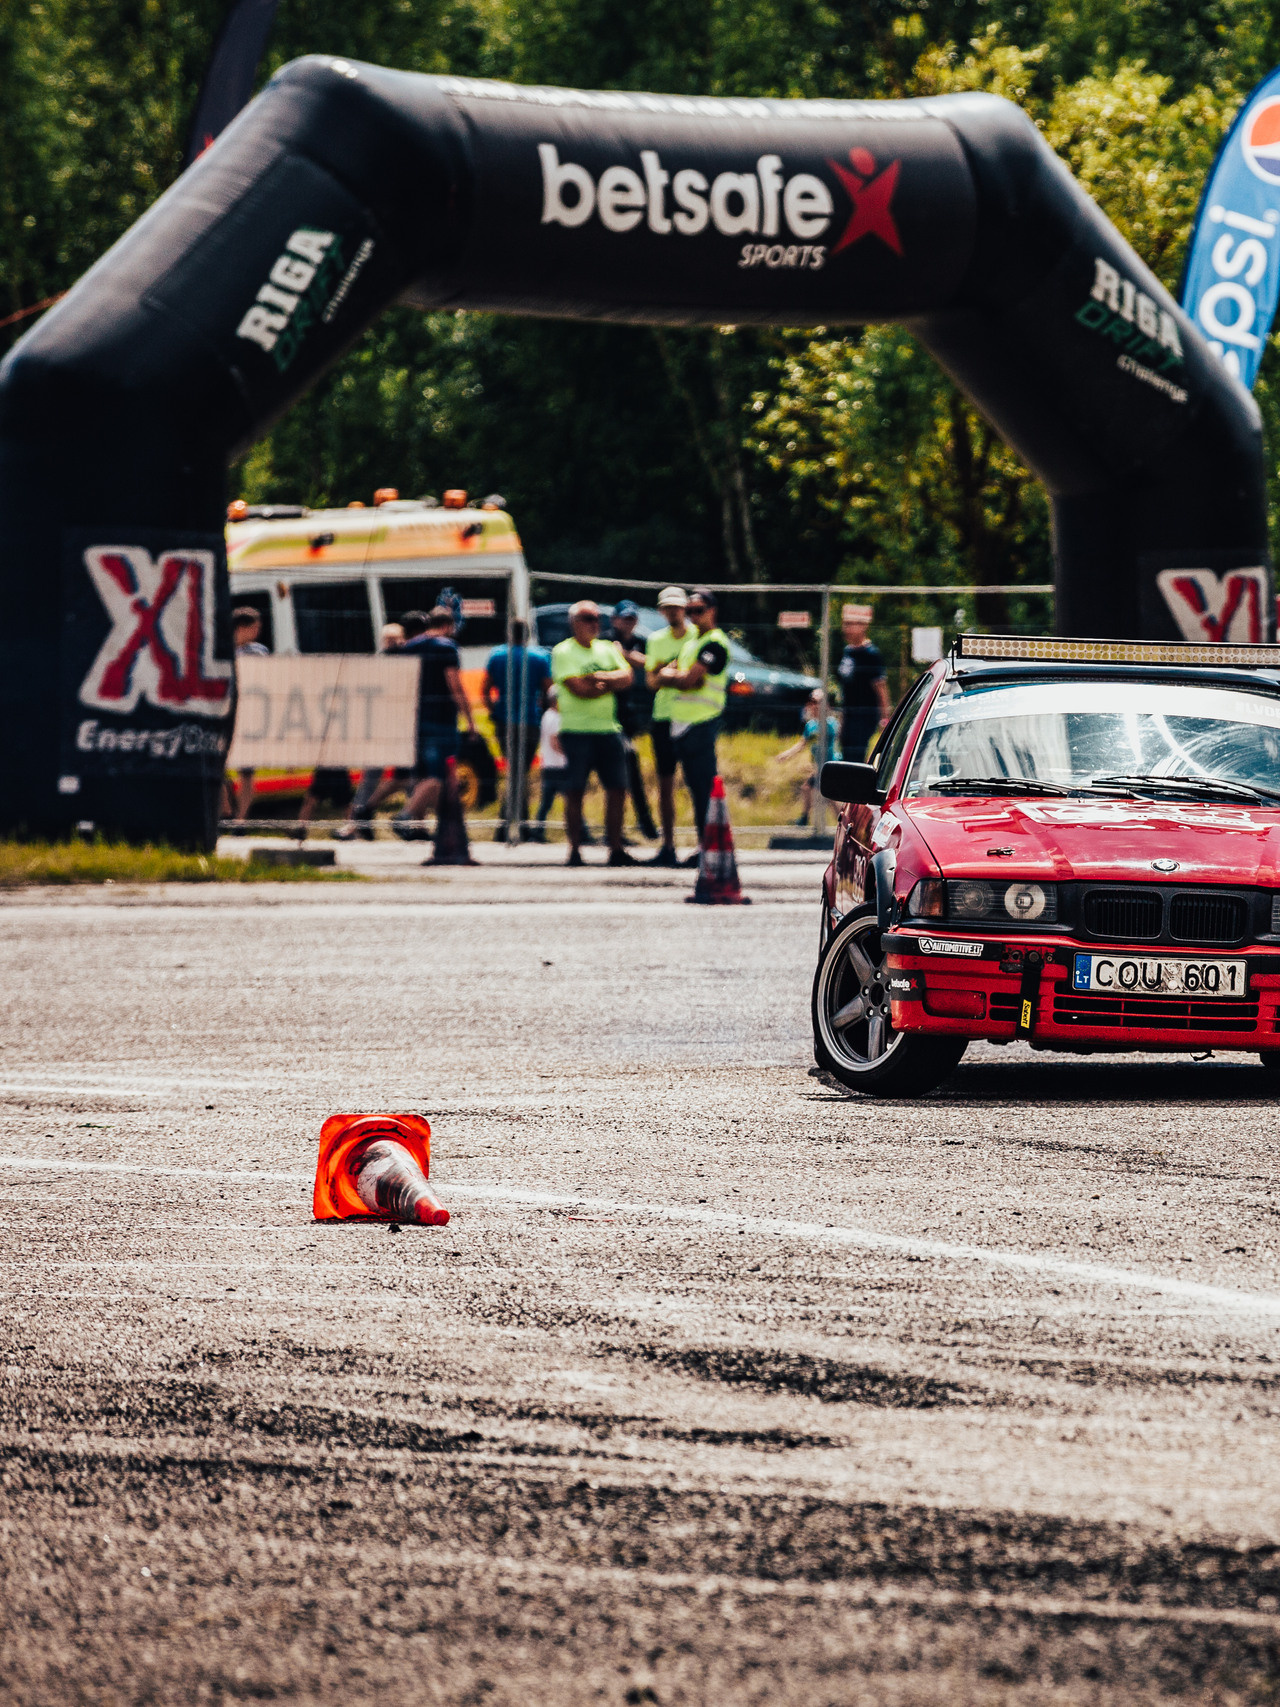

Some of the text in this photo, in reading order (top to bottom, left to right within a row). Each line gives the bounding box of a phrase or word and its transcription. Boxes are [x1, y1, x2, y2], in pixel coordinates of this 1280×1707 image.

[537, 143, 834, 239] betsafe
[236, 229, 335, 351] RIGA
[738, 243, 826, 270] SPORTS
[1090, 258, 1184, 357] RIGA
[80, 545, 234, 718] XL
[931, 943, 983, 954] AUTOMOTIVE.LT
[1076, 960, 1238, 991] LT COU 601
